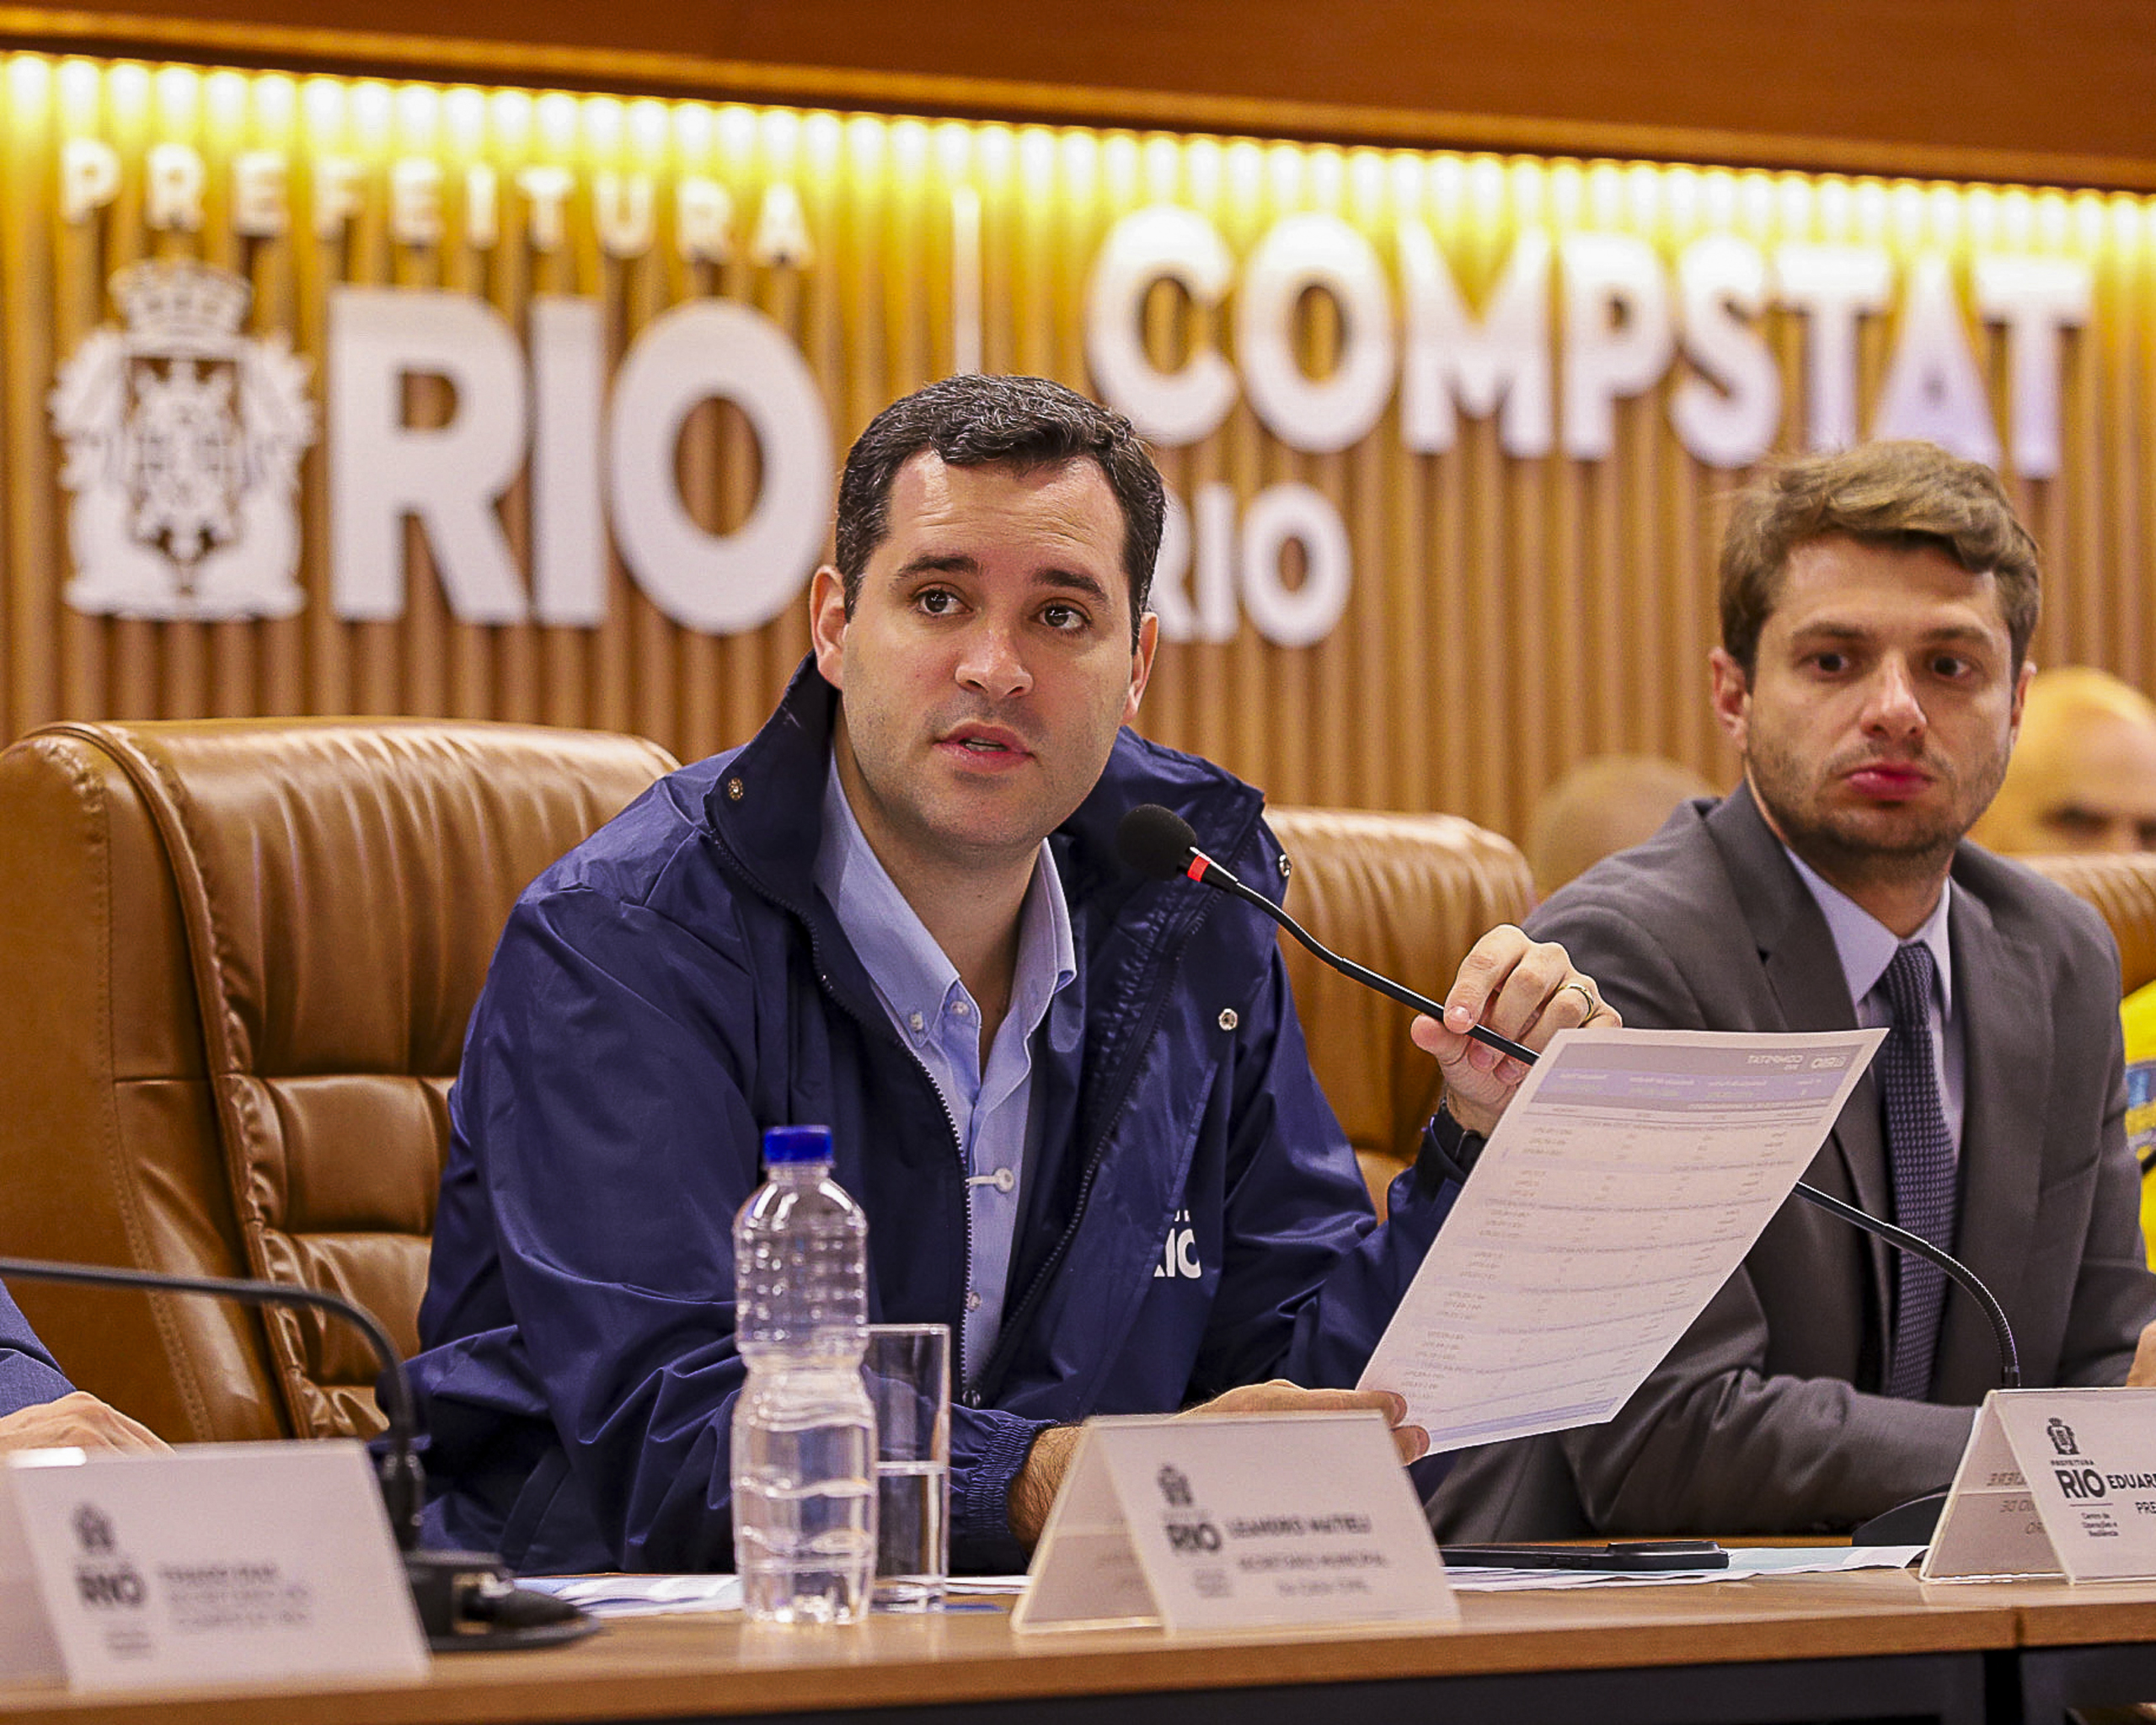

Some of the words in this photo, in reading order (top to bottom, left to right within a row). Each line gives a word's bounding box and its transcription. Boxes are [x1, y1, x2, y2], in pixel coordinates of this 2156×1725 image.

[59, 137, 814, 266] PREFEITURA
[1084, 206, 2092, 478] COMPSTAT
[327, 284, 834, 635] RIO
[1153, 1228, 1201, 1278] IO
[2055, 1469, 2105, 1498] RIO
[2135, 1501, 2156, 1514] PRE
[1166, 1522, 1222, 1552] RIO
[75, 1572, 146, 1606] RIO
